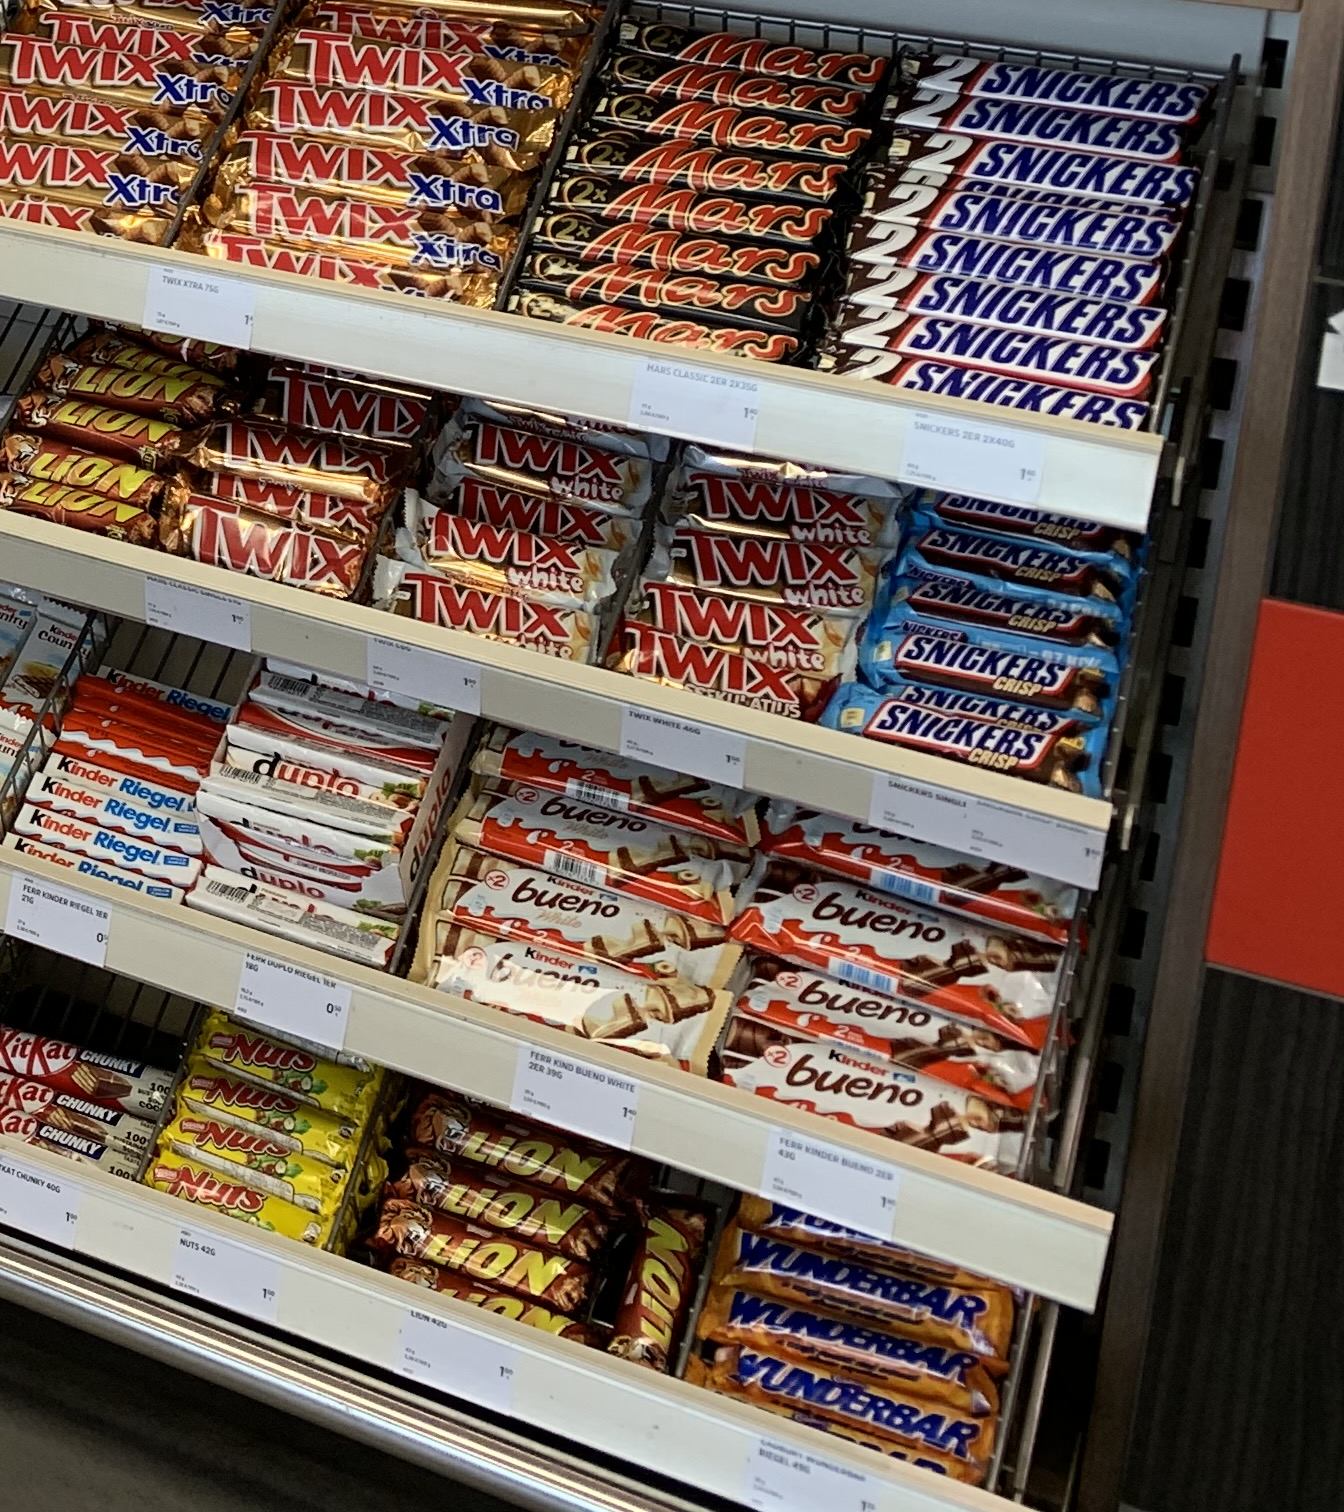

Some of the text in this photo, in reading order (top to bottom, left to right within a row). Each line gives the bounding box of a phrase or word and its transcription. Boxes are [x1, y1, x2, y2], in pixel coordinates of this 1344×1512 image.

[984, 63, 1211, 121] SNICKERS
[601, 184, 836, 242] Mars
[162, 276, 219, 294] TWIX XTRA 75G
[917, 233, 1164, 305] SNICKERS
[646, 363, 676, 376] MARS
[678, 368, 709, 384] CLASSIC
[789, 523, 872, 546] white
[27, 805, 163, 863] Kinder Riegel
[528, 1061, 563, 1080] 2ER 39G
[530, 1051, 636, 1094] FERR KIND BUENO WHITE
[787, 1057, 924, 1110] bueno
[828, 1048, 889, 1076] Kinder
[39, 1122, 103, 1157] CHUNKY
[462, 1128, 602, 1190] LION
[176, 1161, 267, 1210] Nuts
[179, 1236, 217, 1257] NUTS 42G
[410, 1310, 429, 1323] LION
[735, 1351, 981, 1459] WUNDERBAR
